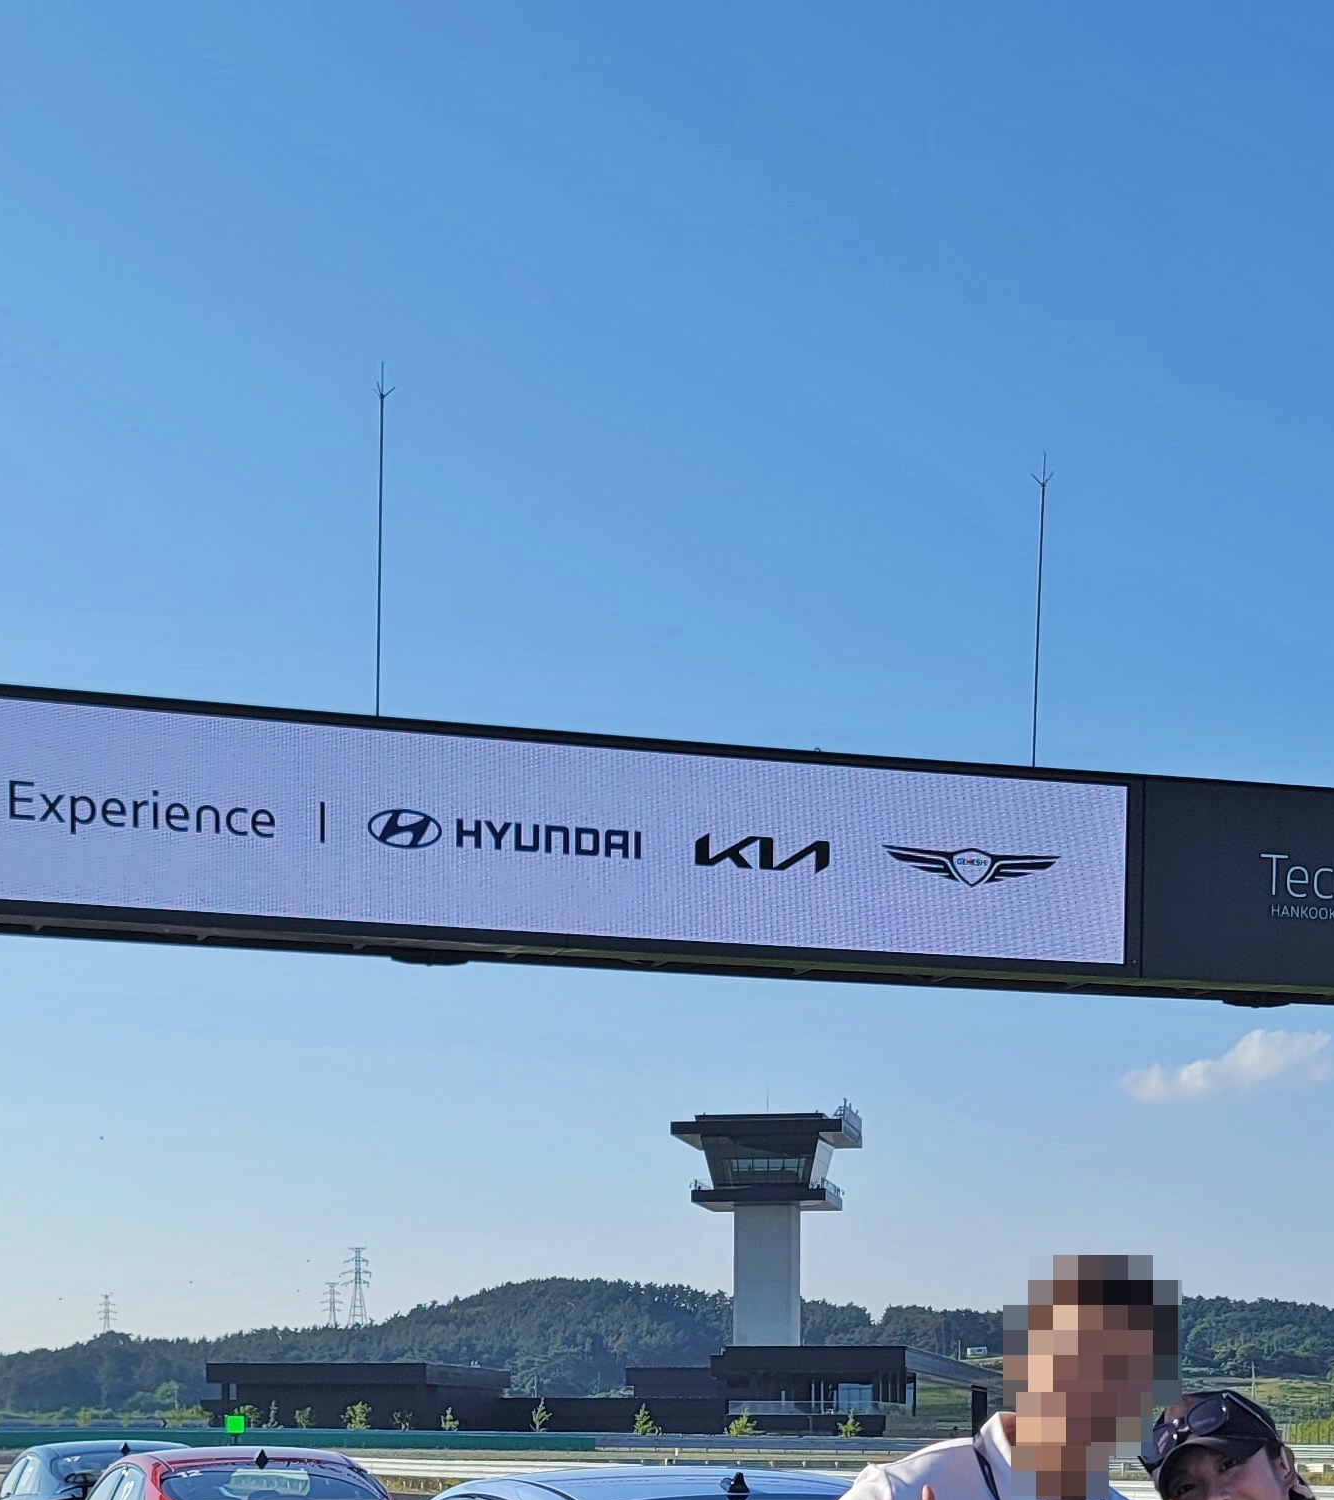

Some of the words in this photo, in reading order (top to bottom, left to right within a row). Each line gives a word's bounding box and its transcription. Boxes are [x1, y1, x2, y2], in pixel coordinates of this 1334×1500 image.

[8, 779, 276, 839] Experience
[456, 817, 642, 860] HYUNDAI
[177, 1469, 203, 1478] 12
